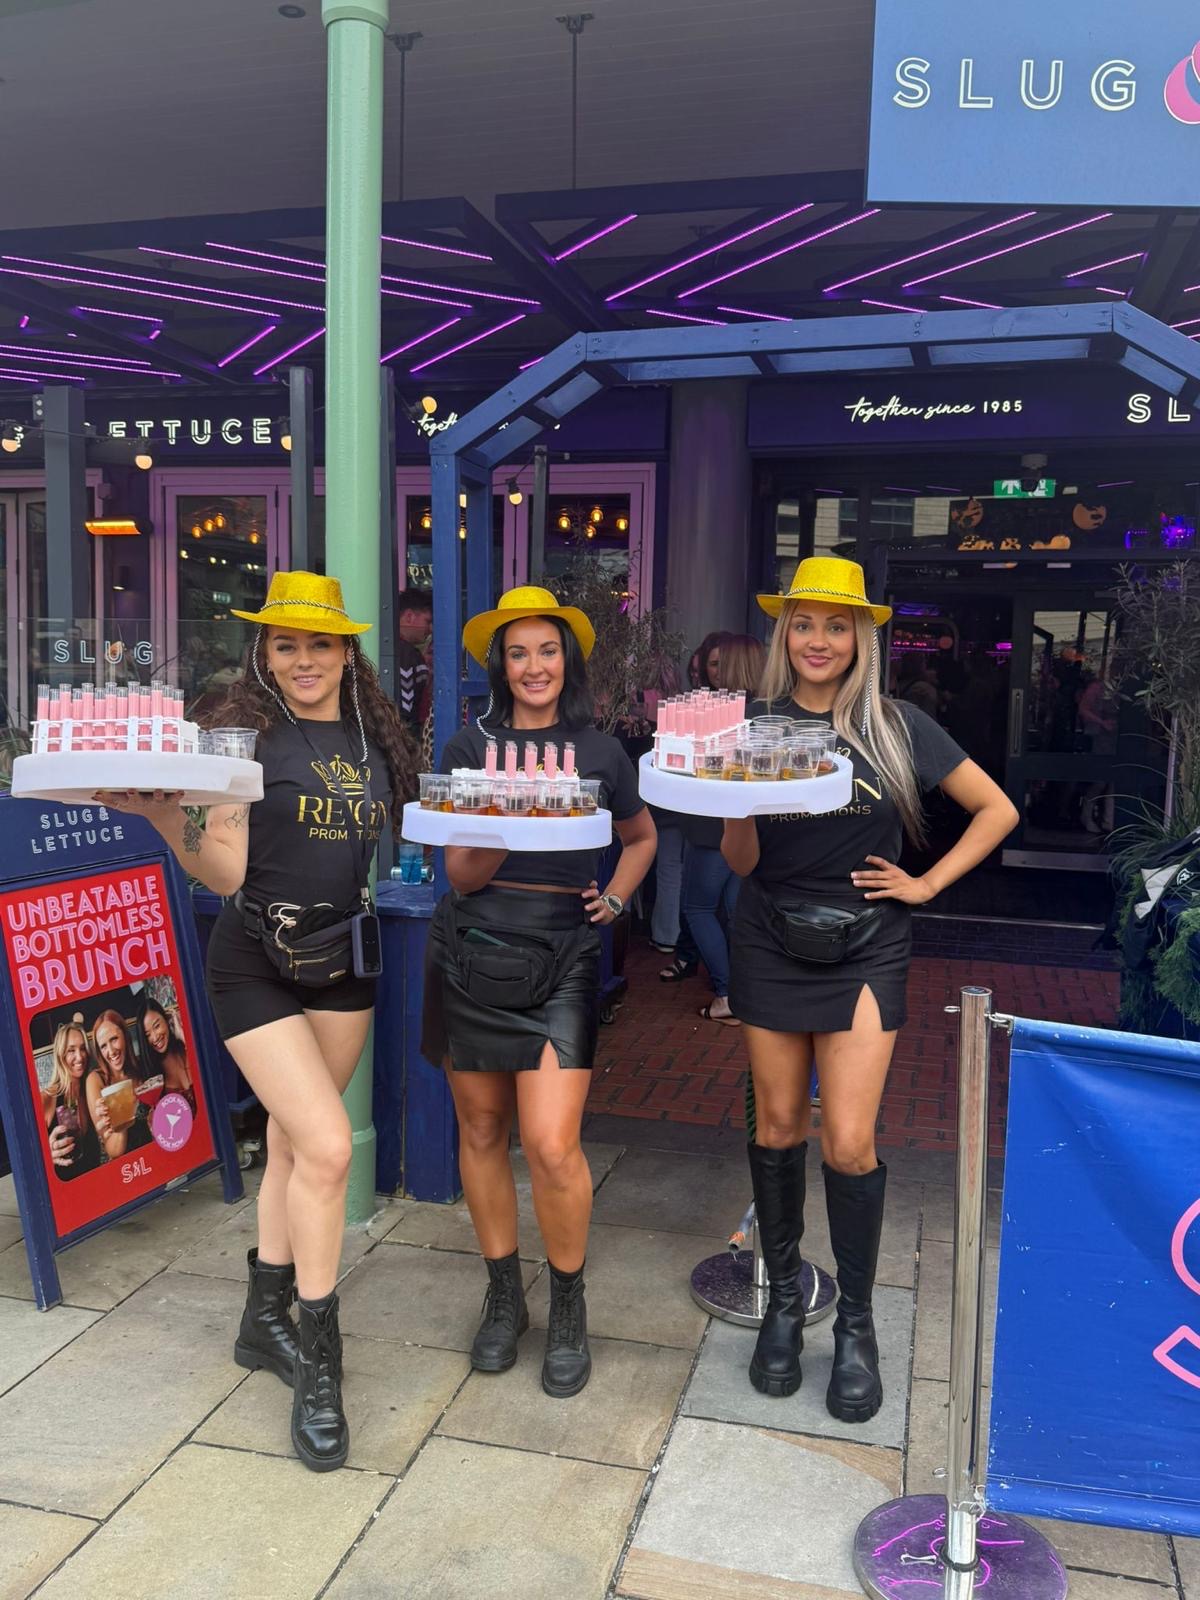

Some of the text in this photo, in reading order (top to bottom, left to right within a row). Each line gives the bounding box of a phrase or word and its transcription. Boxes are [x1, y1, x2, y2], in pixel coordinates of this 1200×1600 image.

[893, 56, 1137, 111] SLUG
[843, 395, 1023, 423] together since 1985
[84, 417, 272, 445] ETTUCE
[412, 412, 459, 437] toget
[54, 640, 153, 665] SLUG
[40, 808, 93, 829] SLUG
[297, 795, 387, 826] REG
[769, 805, 873, 823] PROMTIONS
[31, 825, 125, 854] LETTUCE
[7, 875, 160, 931] UNBEATABLE
[12, 903, 164, 963] BOTTOMLESS
[18, 930, 171, 1009] BRUNCH
